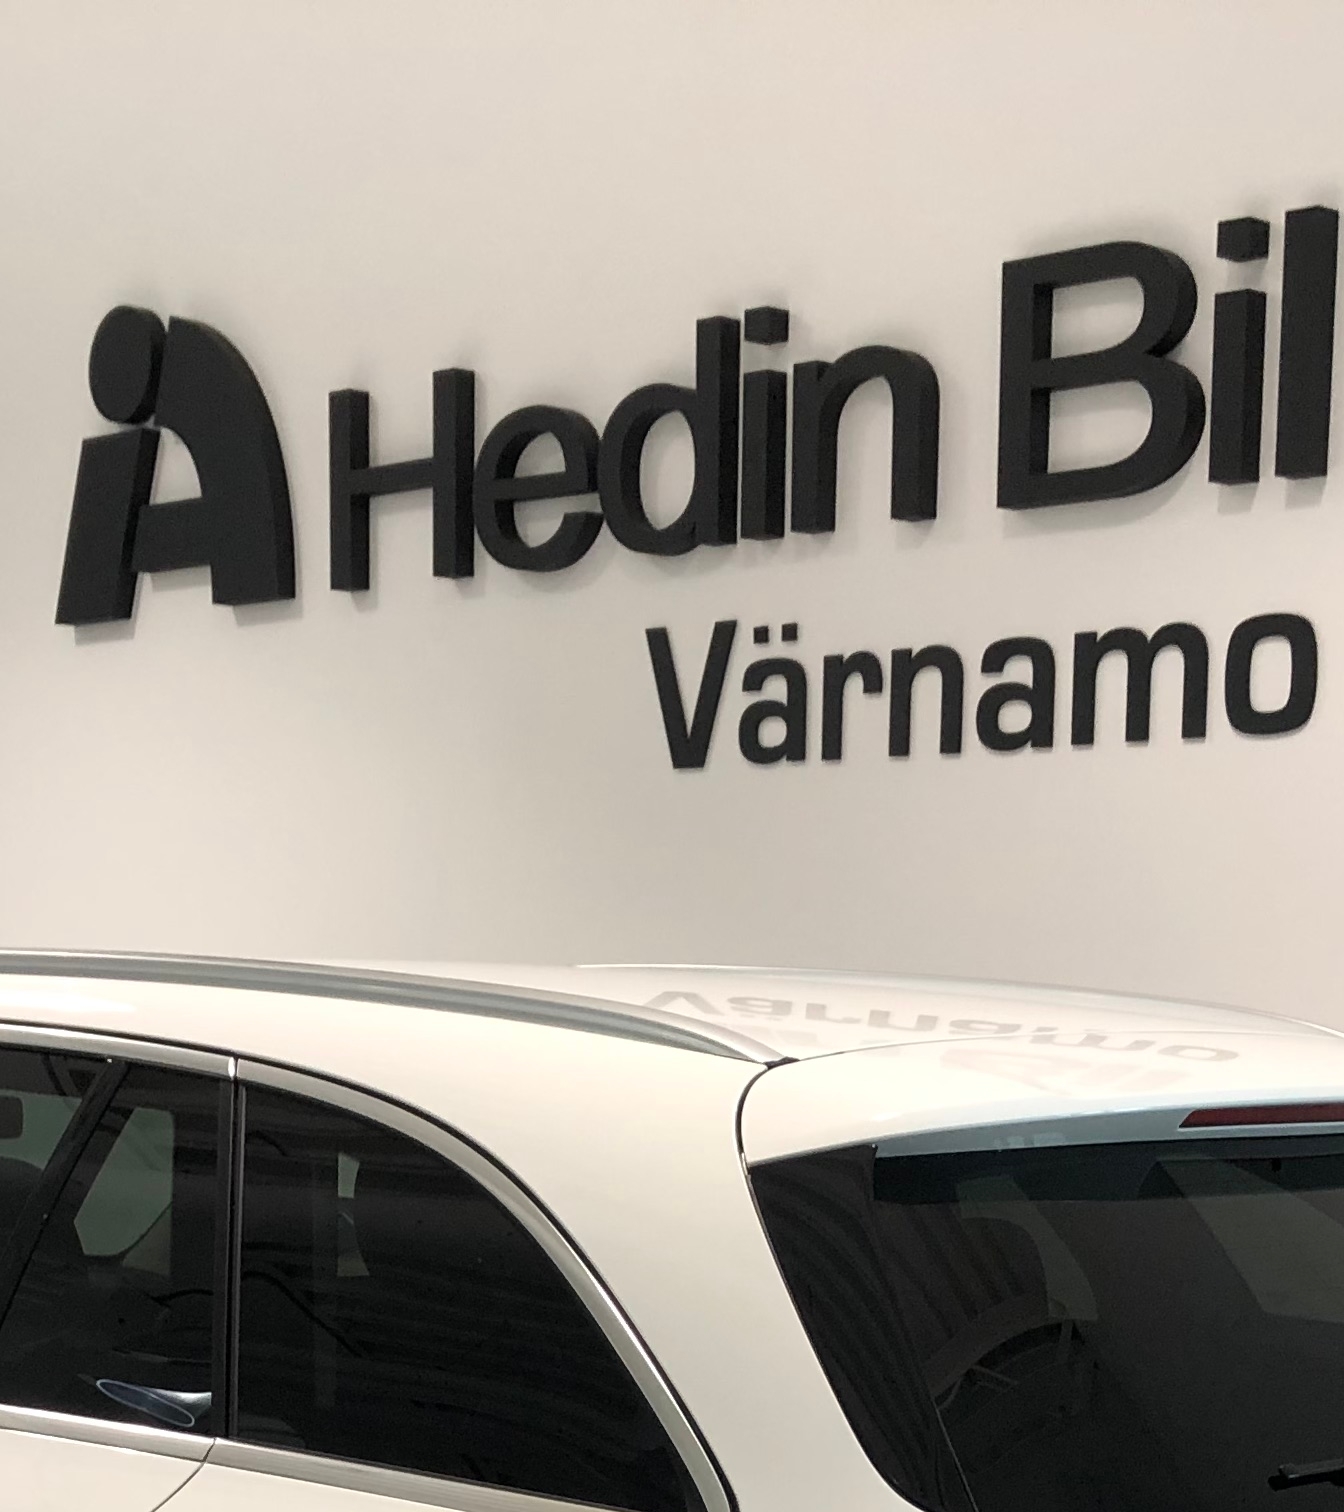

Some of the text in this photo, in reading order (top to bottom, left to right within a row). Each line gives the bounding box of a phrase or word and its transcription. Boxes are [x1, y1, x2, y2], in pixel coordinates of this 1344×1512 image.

[328, 305, 942, 594] Hedin
[996, 204, 1341, 511] Bil
[644, 612, 1319, 770] Värnamo
